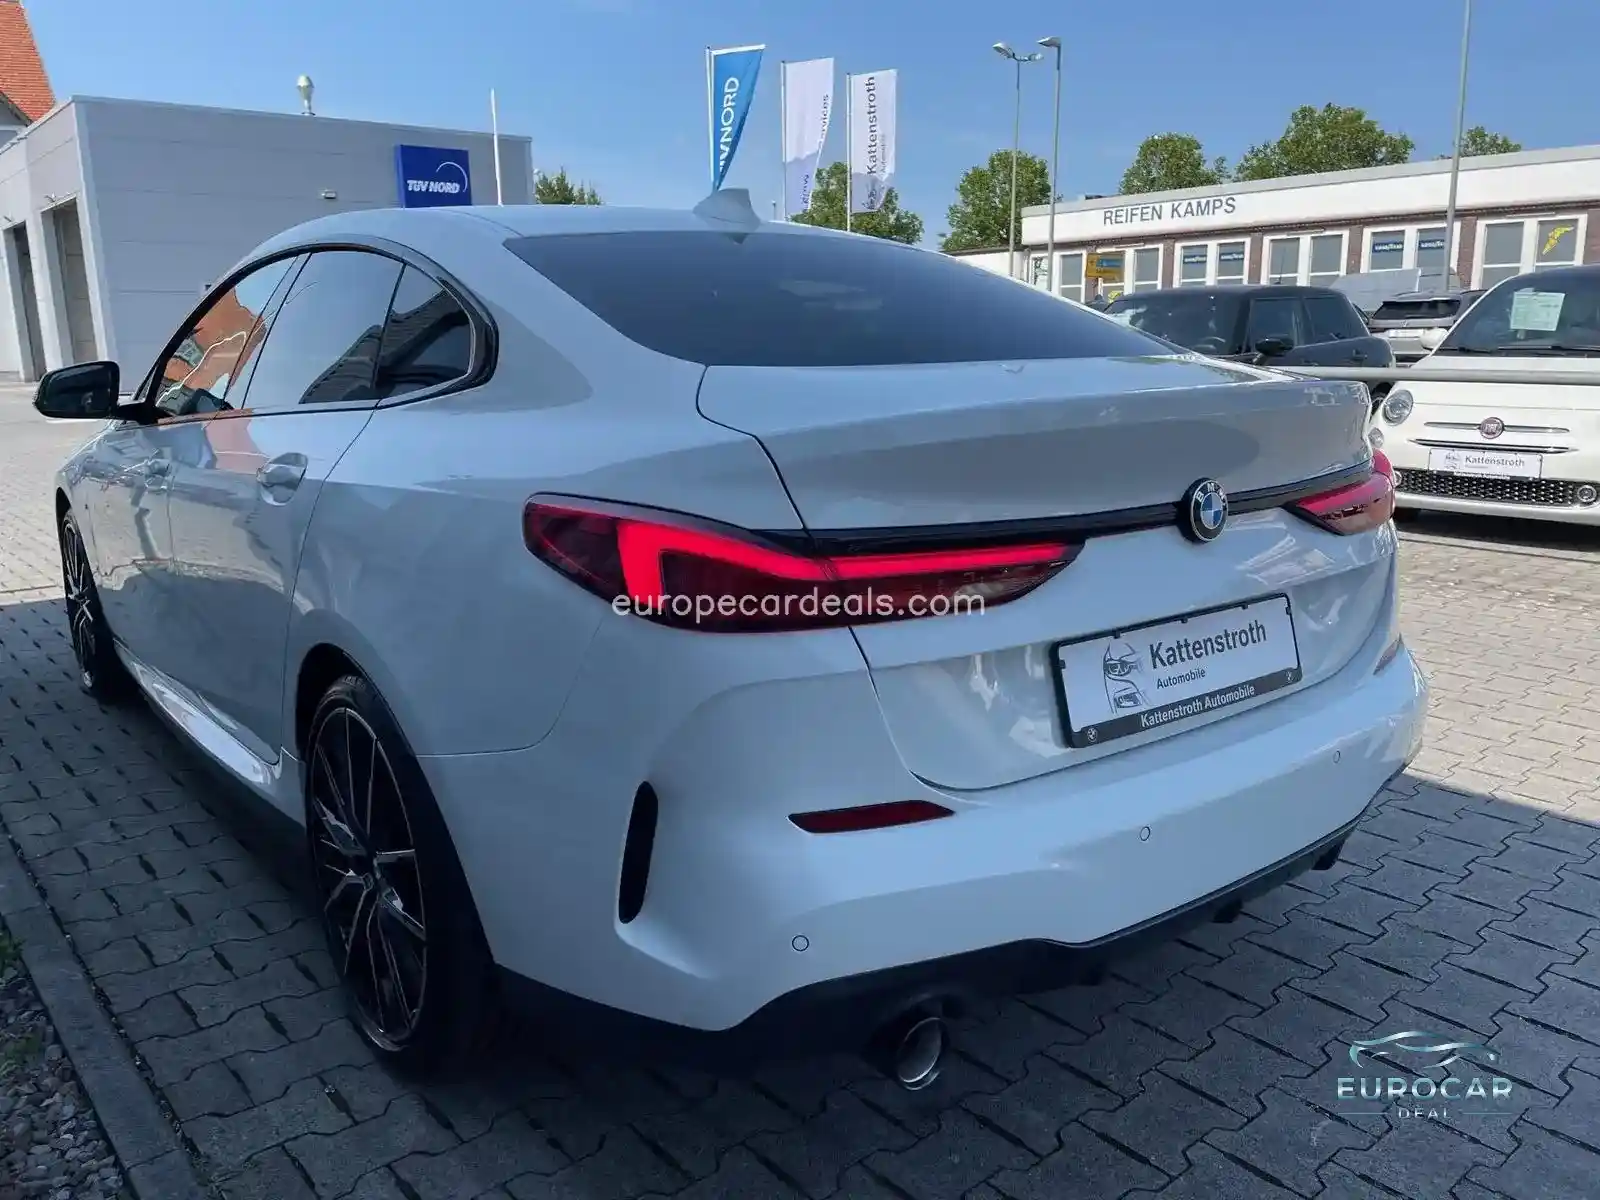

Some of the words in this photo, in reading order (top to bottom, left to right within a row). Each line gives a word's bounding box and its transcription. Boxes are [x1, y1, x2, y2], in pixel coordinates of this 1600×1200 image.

[865, 76, 877, 174] Kattenstroth
[407, 180, 429, 191] TÜV
[429, 181, 460, 194] NORD
[1103, 205, 1162, 226] REIFEN
[1170, 197, 1236, 218] KAMPS
[1465, 455, 1525, 467] Kattenstroth
[1196, 482, 1226, 502] BMW
[1149, 620, 1267, 669] Kattenstroth
[1156, 667, 1206, 690] Automobile
[1140, 699, 1203, 728] Kattenstroth
[1204, 684, 1255, 709] Automobile
